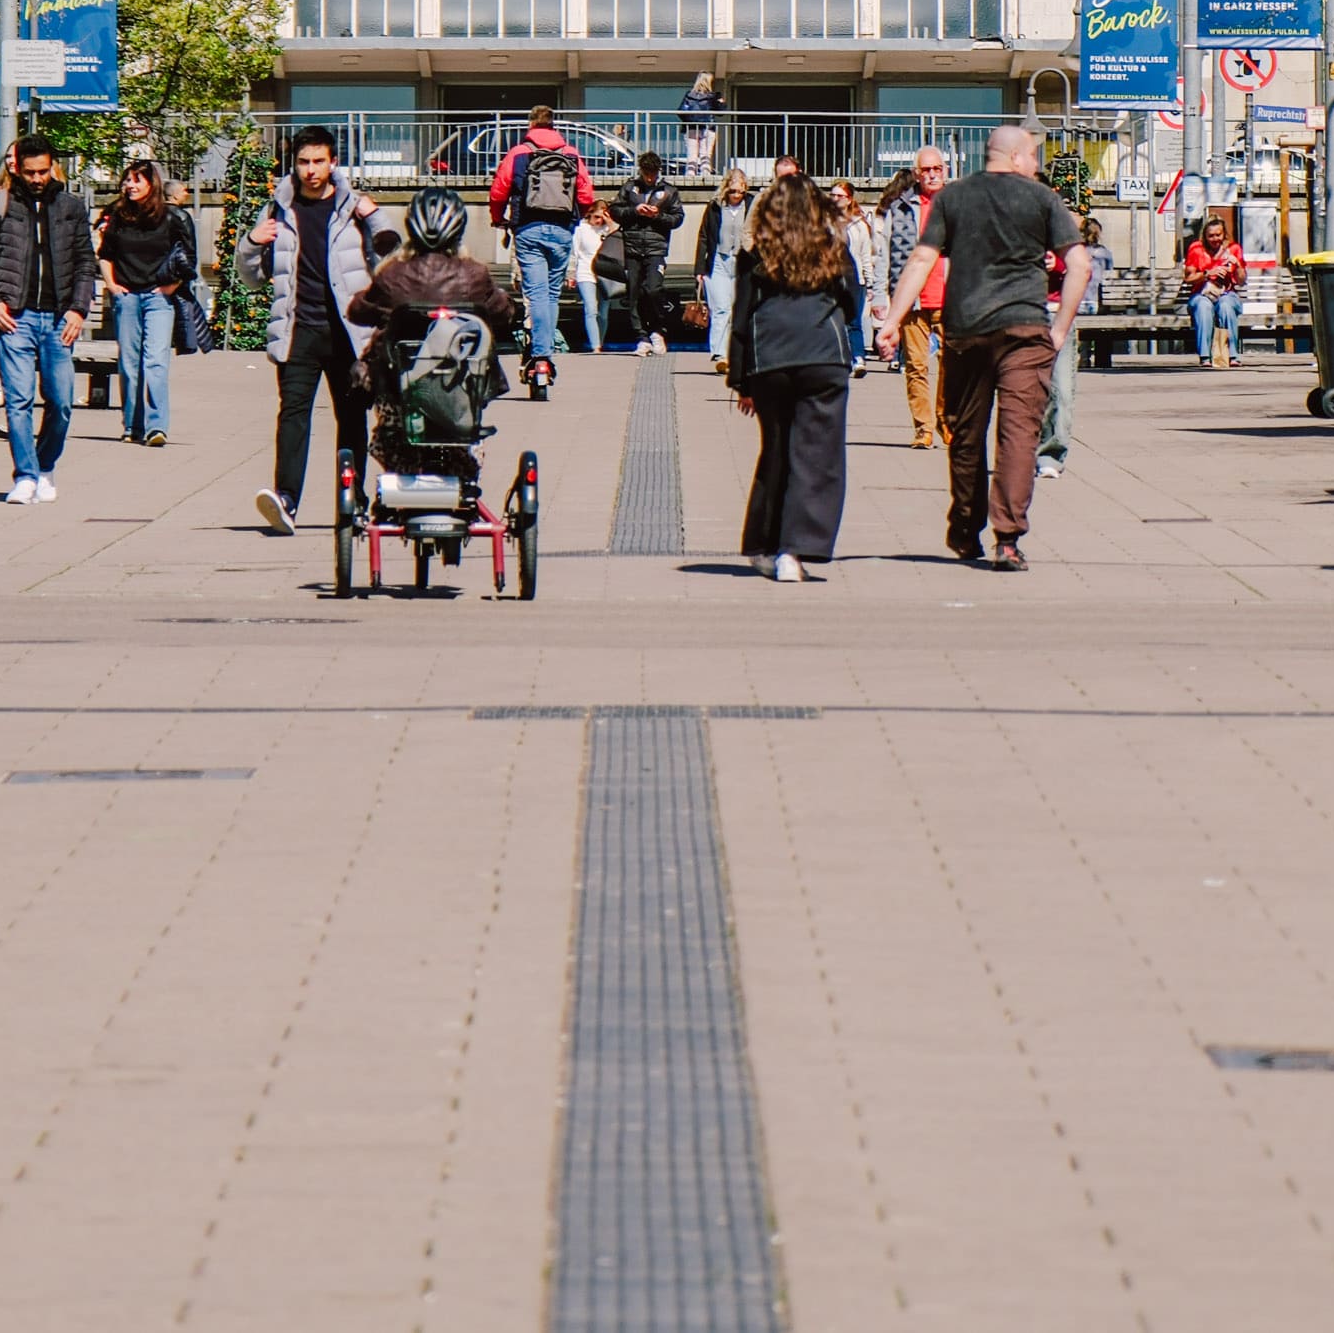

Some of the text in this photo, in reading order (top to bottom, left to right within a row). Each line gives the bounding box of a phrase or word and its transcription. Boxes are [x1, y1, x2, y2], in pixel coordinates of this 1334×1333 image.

[1209, 2, 1298, 10] IN GANZ HESSEN.
[1087, 0, 1172, 40] Barock.
[1090, 64, 1106, 72] FÜR
